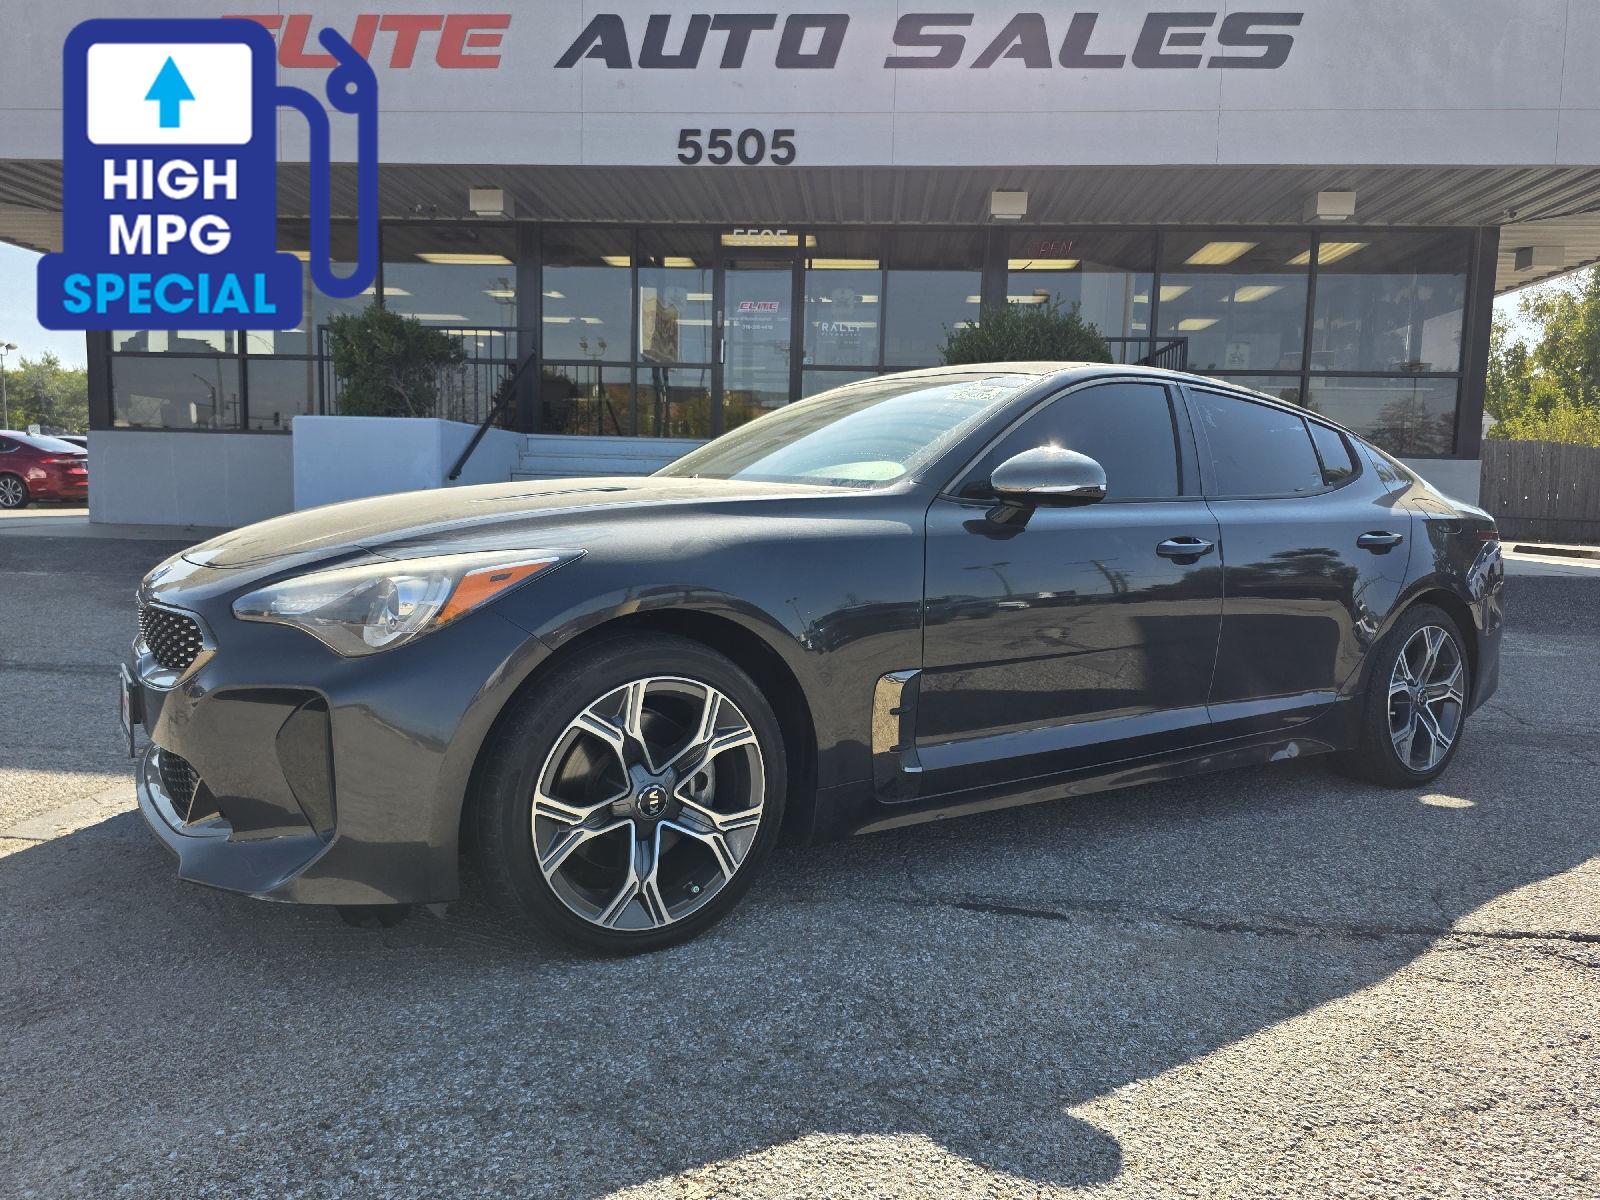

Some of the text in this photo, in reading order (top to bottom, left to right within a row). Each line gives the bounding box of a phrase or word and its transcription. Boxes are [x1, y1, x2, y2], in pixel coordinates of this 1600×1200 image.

[554, 13, 850, 69] AUTO
[884, 12, 1304, 69] SALES
[677, 128, 797, 166] 5505
[739, 301, 779, 310] ELITE
